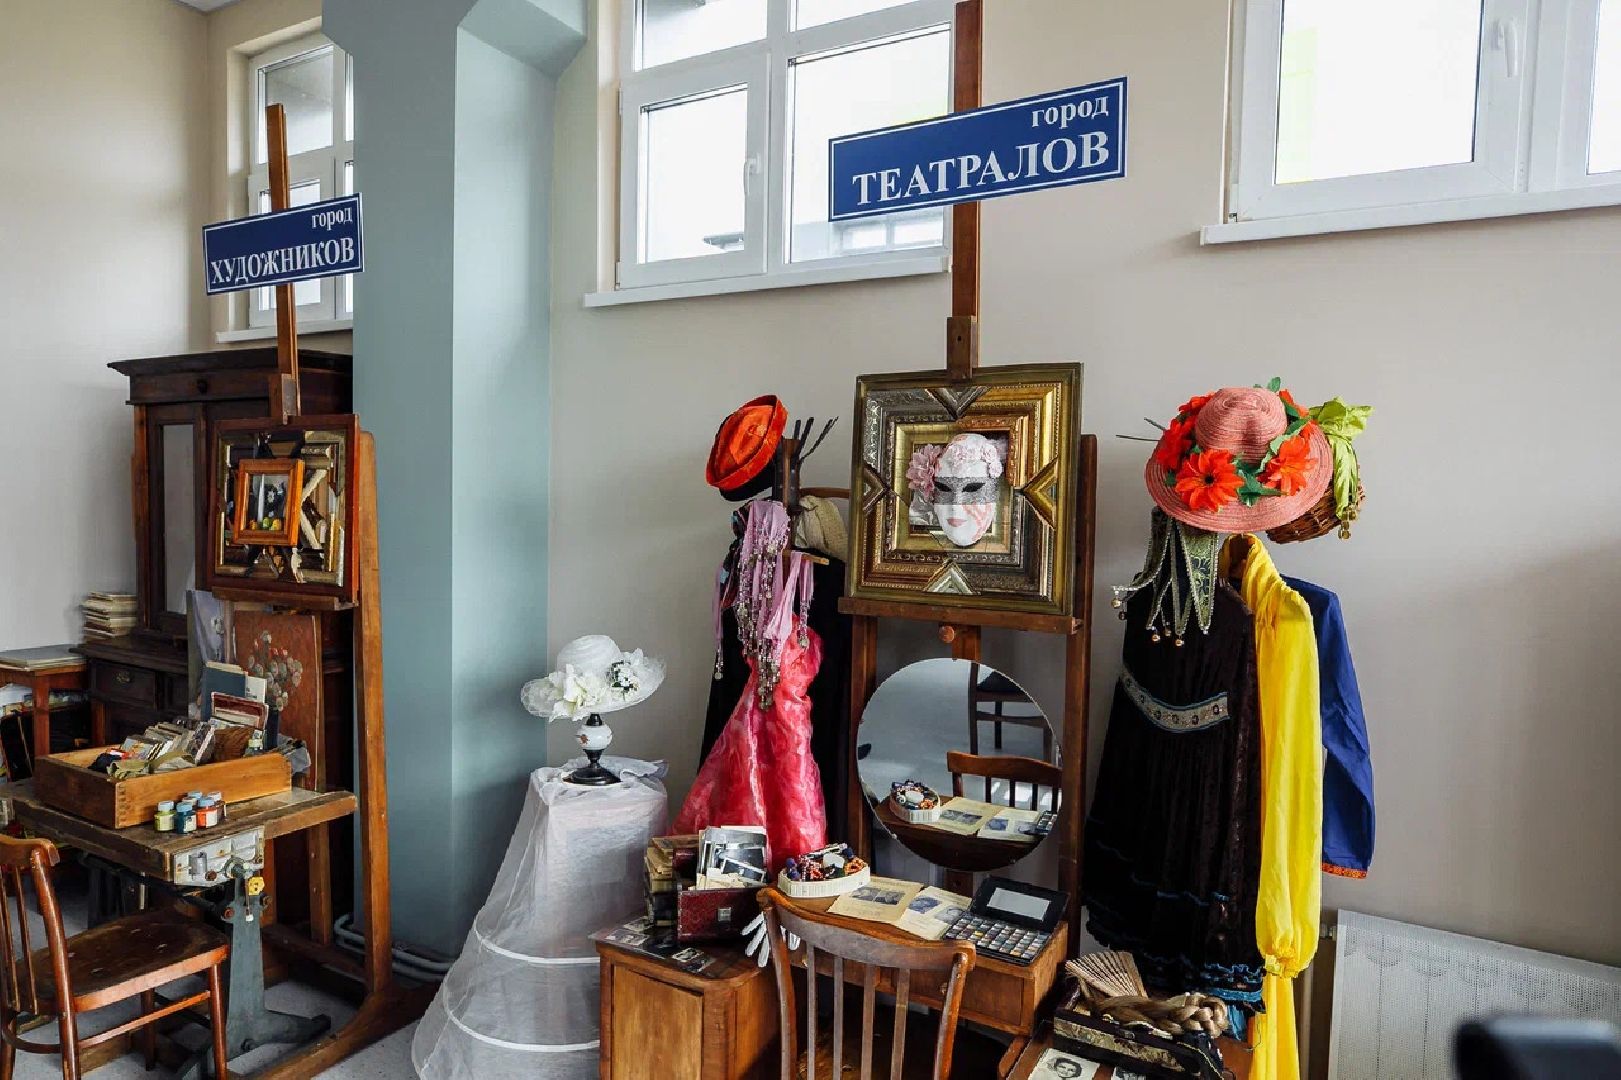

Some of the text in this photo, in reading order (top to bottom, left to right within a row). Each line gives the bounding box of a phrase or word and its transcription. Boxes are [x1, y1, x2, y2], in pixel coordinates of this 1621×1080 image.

[1031, 96, 1109, 129] город
[852, 131, 1110, 206] ТЕАТРАЛОВ
[311, 207, 353, 231] город
[211, 237, 355, 285] ХУДОЖНИКОВ
